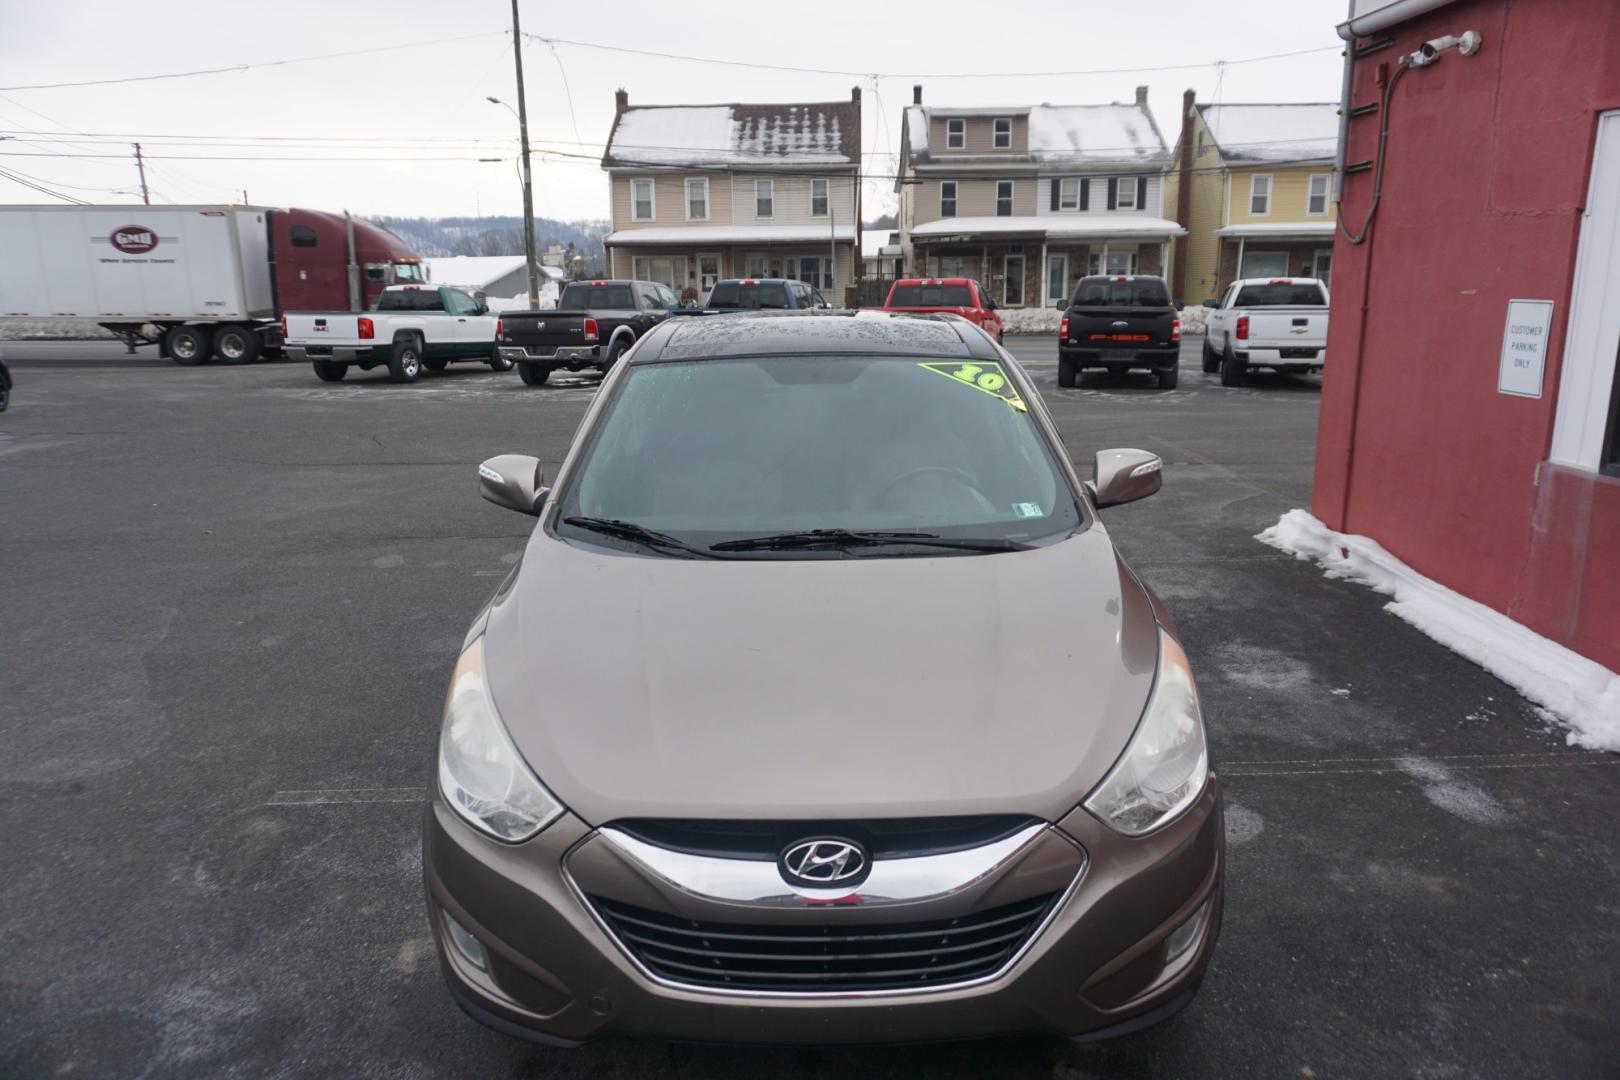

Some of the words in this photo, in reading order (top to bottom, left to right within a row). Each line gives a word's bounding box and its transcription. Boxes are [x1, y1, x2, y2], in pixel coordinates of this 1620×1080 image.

[116, 232, 152, 245] GMH
[1511, 324, 1543, 336] CUSTOMER
[1511, 341, 1538, 353] PARKING
[1514, 358, 1530, 369] ONLY
[953, 364, 1004, 390] 10
